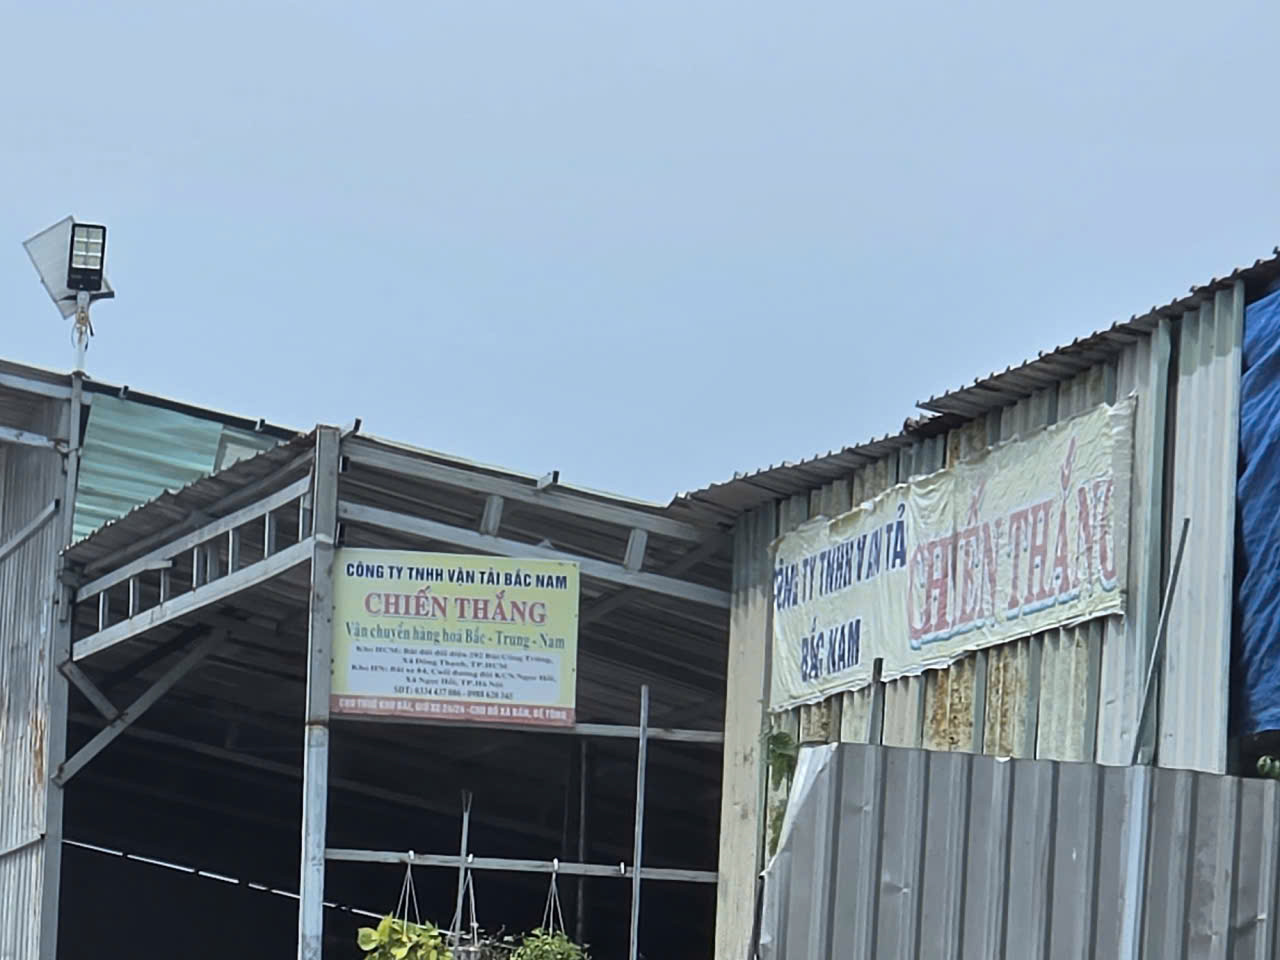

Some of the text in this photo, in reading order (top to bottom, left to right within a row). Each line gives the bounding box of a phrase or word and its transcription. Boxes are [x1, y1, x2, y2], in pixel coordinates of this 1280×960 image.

[346, 561, 567, 589] CÔNG TY TNHH VẬN TẢI BẮC NAM
[803, 555, 817, 603] TY
[364, 585, 546, 624] CHIẾN THẮNG
[496, 630, 530, 648] Trung
[540, 633, 565, 649] Nam
